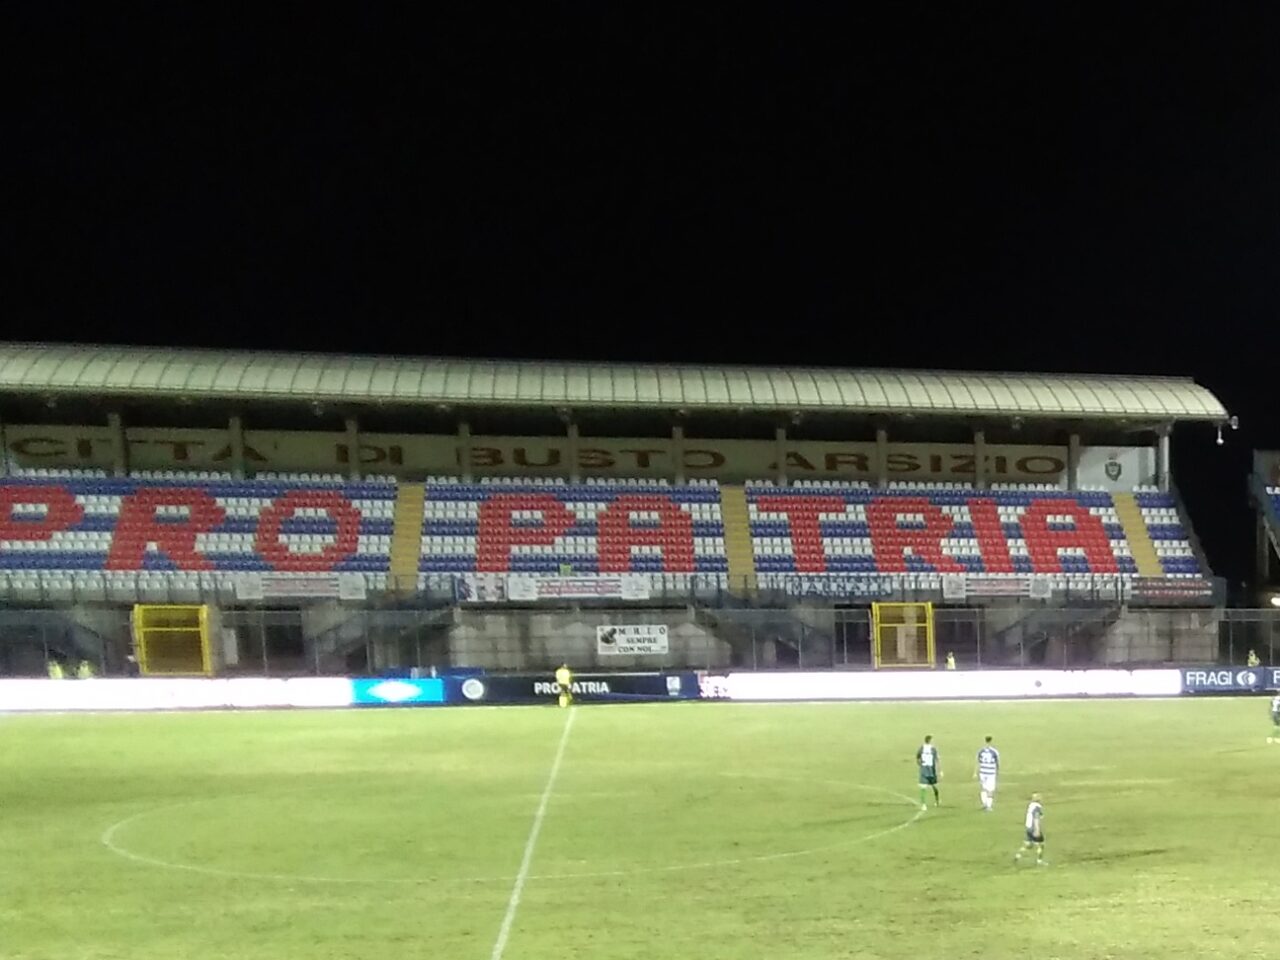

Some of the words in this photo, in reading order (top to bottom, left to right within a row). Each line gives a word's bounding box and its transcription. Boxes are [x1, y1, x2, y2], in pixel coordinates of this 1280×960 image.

[336, 442, 403, 465] DI
[457, 447, 726, 469] BUSTO
[768, 451, 1067, 475] ARSIZIO
[0, 485, 362, 572] PRO
[474, 492, 1121, 573] PATRIA
[533, 681, 562, 694] PRO
[1186, 671, 1233, 686] FRAGI
